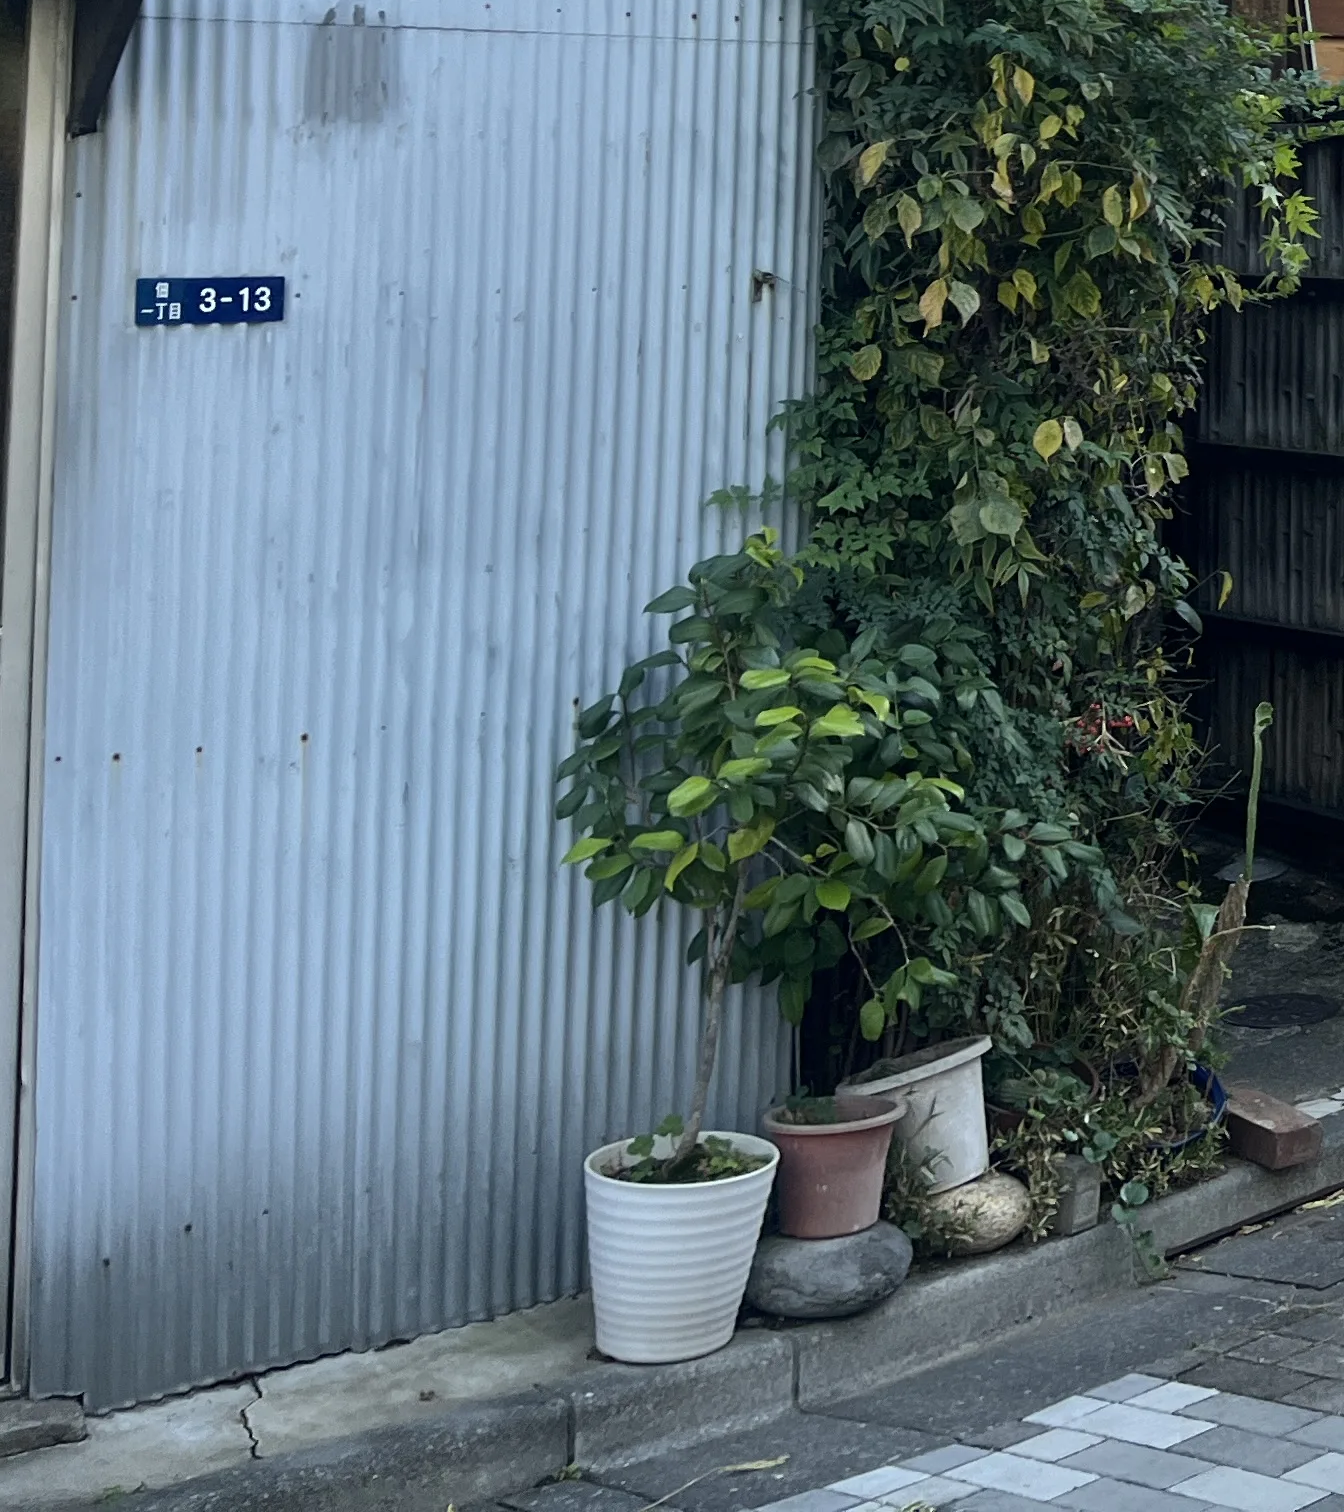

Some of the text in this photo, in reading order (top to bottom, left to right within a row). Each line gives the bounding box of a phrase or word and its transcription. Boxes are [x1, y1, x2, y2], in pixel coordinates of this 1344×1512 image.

[140, 302, 182, 320] 一丁目
[198, 285, 272, 314] 3-13
